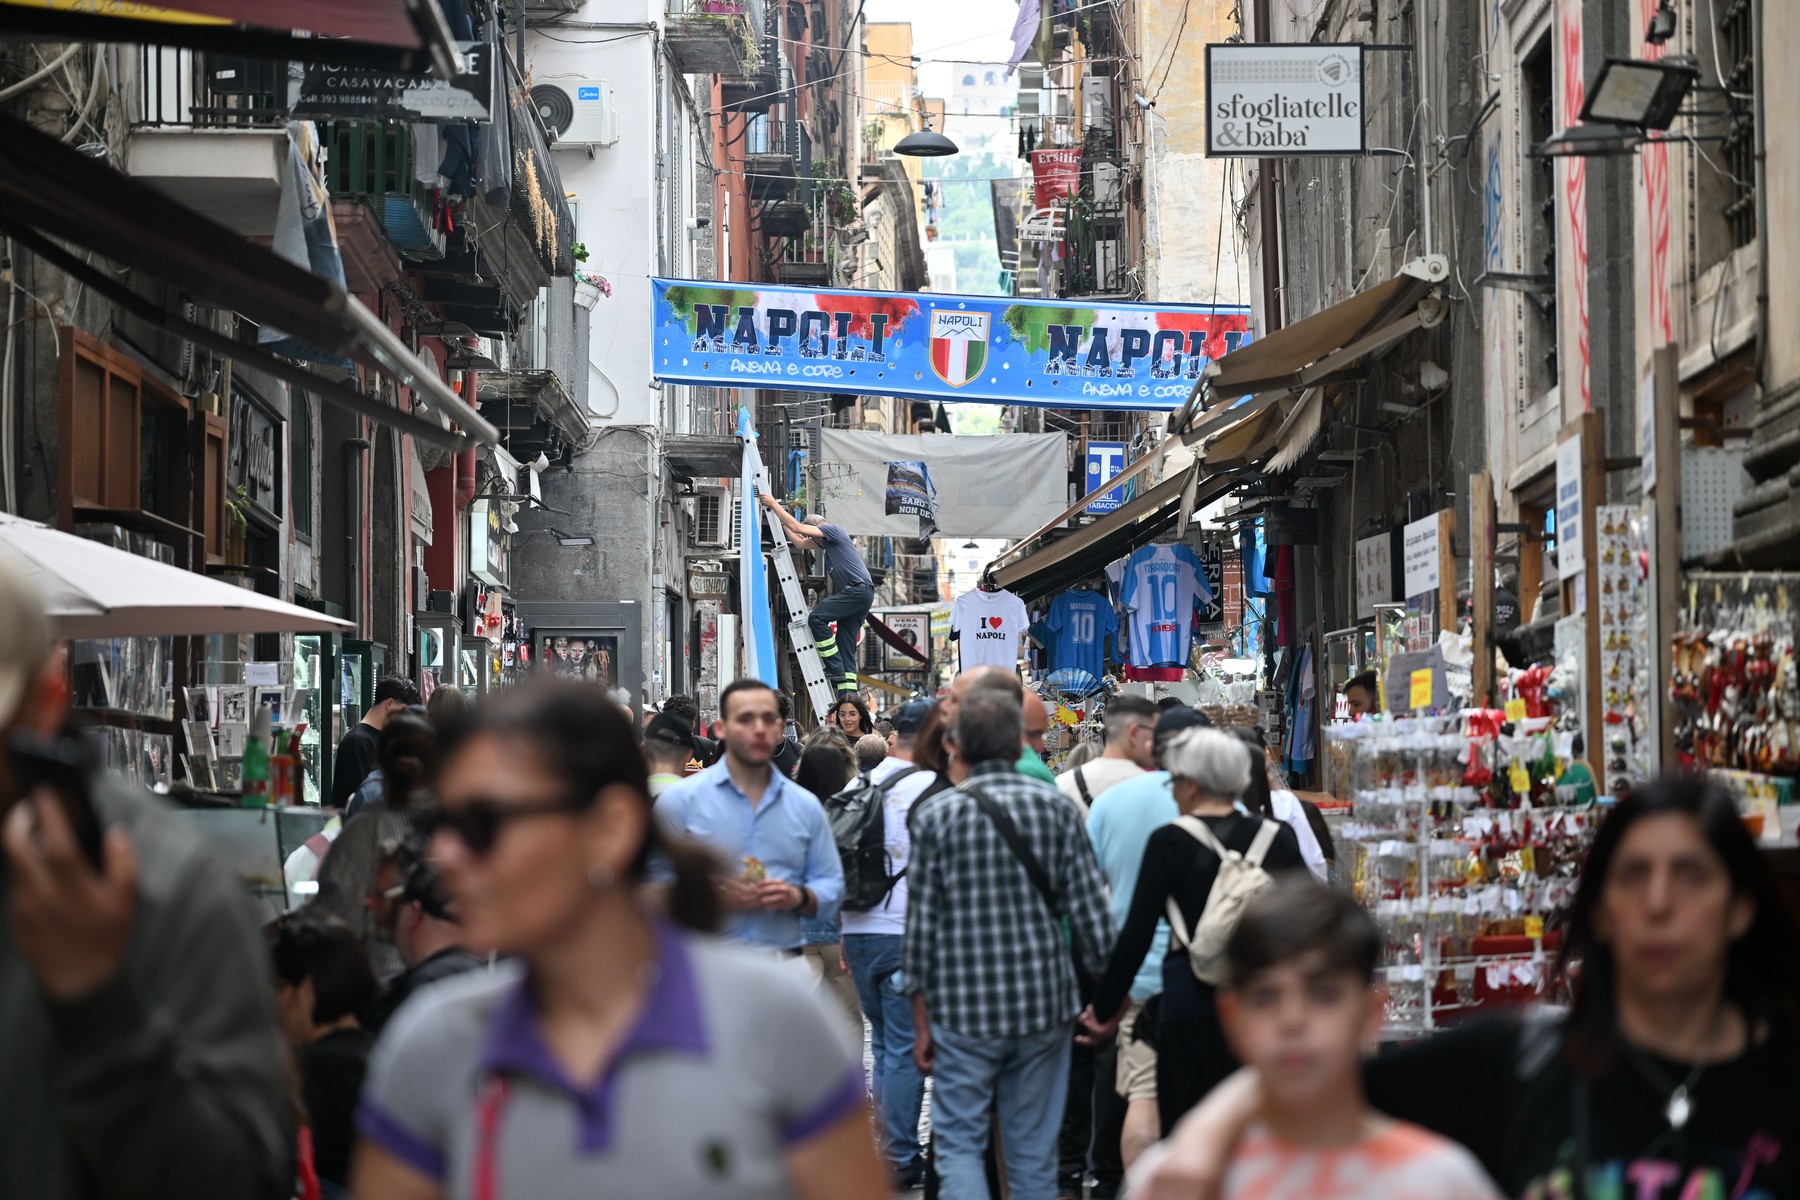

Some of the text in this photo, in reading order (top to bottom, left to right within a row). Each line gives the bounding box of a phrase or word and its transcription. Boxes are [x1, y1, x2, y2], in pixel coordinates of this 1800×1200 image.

[320, 94, 337, 103] 393
[1217, 93, 1358, 127] sfogliatelle
[691, 303, 889, 363] NAPOLI
[938, 315, 983, 327] NAPOLI
[1089, 447, 1123, 486] T
[898, 505, 918, 514] NON
[1147, 574, 1177, 621] 10
[1208, 543, 1222, 620] ERDA
[976, 631, 1006, 640] NAPOLI
[980, 617, 987, 629] I
[1071, 612, 1095, 645] 10
